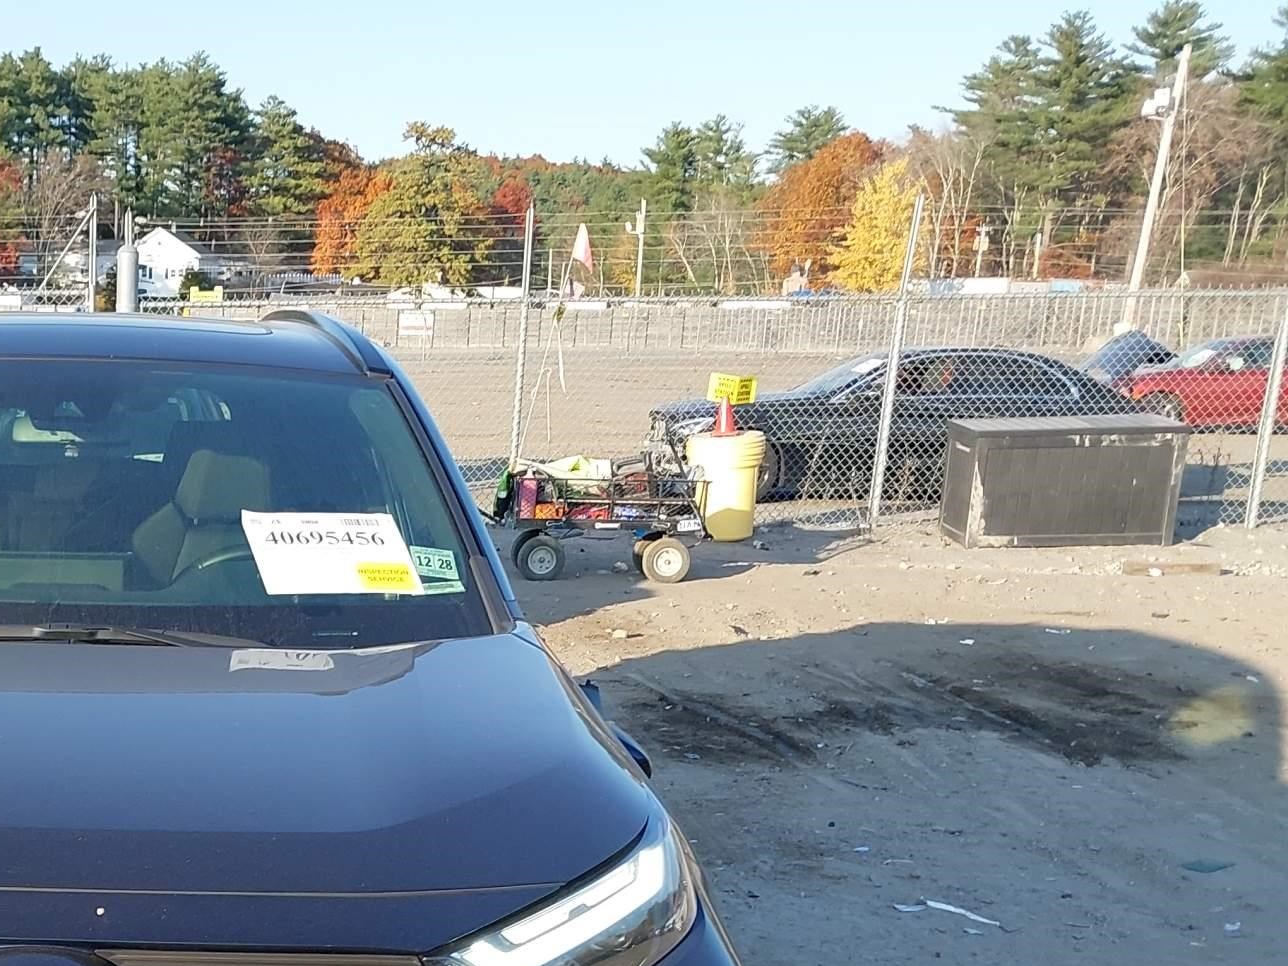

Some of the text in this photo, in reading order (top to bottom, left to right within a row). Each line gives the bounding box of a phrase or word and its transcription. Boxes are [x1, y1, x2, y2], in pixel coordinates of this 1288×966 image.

[265, 531, 385, 546] 40695456
[416, 555, 453, 571] 12 28
